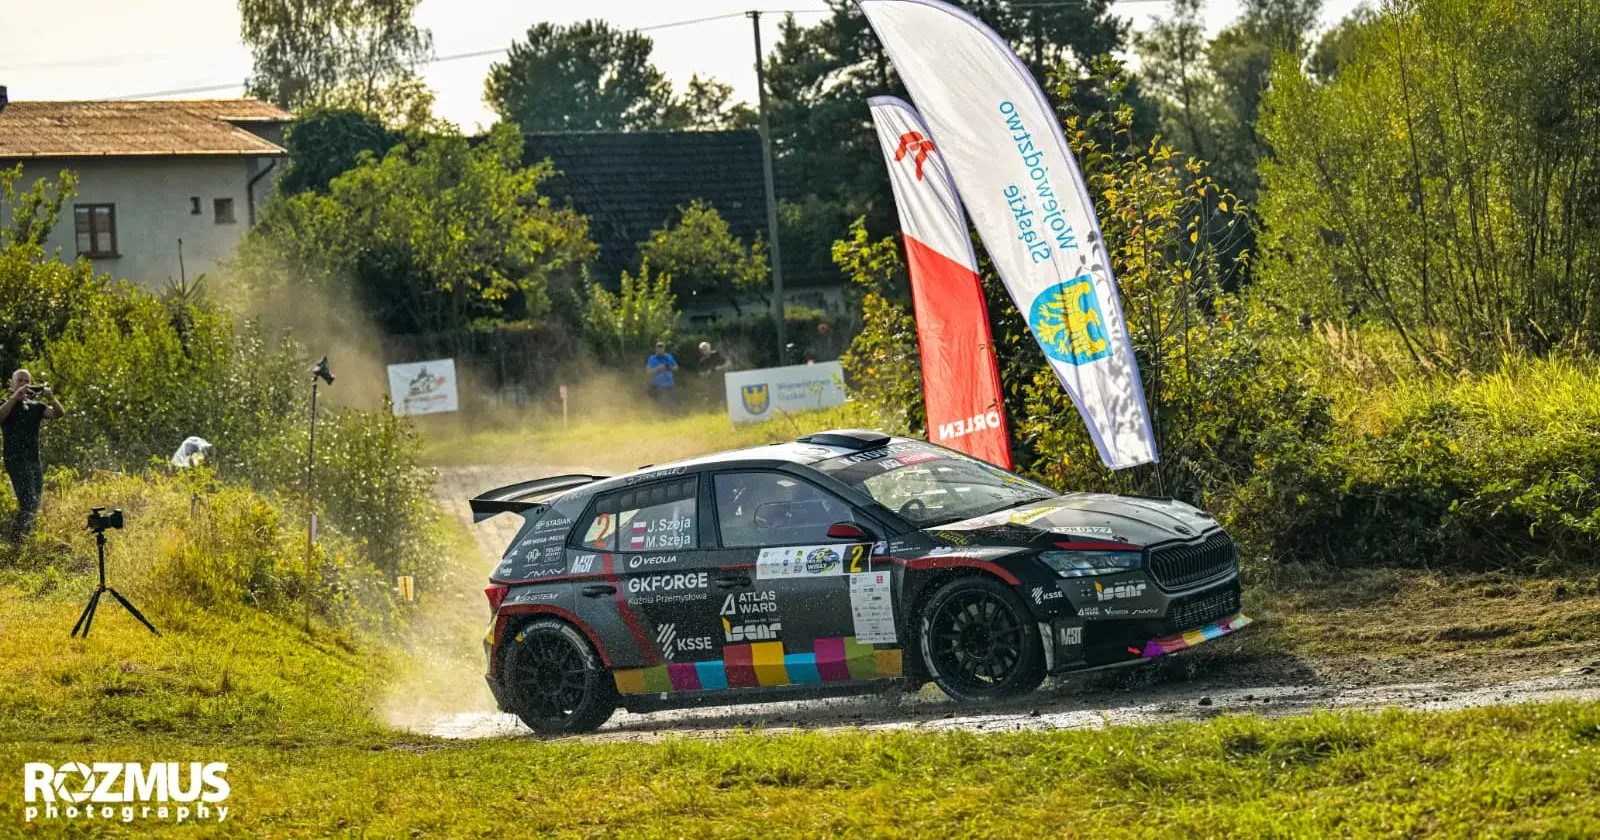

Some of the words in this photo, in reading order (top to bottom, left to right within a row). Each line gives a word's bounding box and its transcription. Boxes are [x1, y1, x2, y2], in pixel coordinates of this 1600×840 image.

[594, 514, 611, 548] 2
[647, 517, 691, 532] J.Szeja
[645, 533, 691, 548] M.Szeja
[643, 555, 677, 565] VEOLIA
[849, 545, 864, 574] 2
[656, 592, 707, 603] Przemysłowa
[739, 590, 776, 602] ATLAS
[1043, 591, 1063, 600] KSSE
[739, 602, 777, 614] WARD
[676, 637, 713, 651] KSSE
